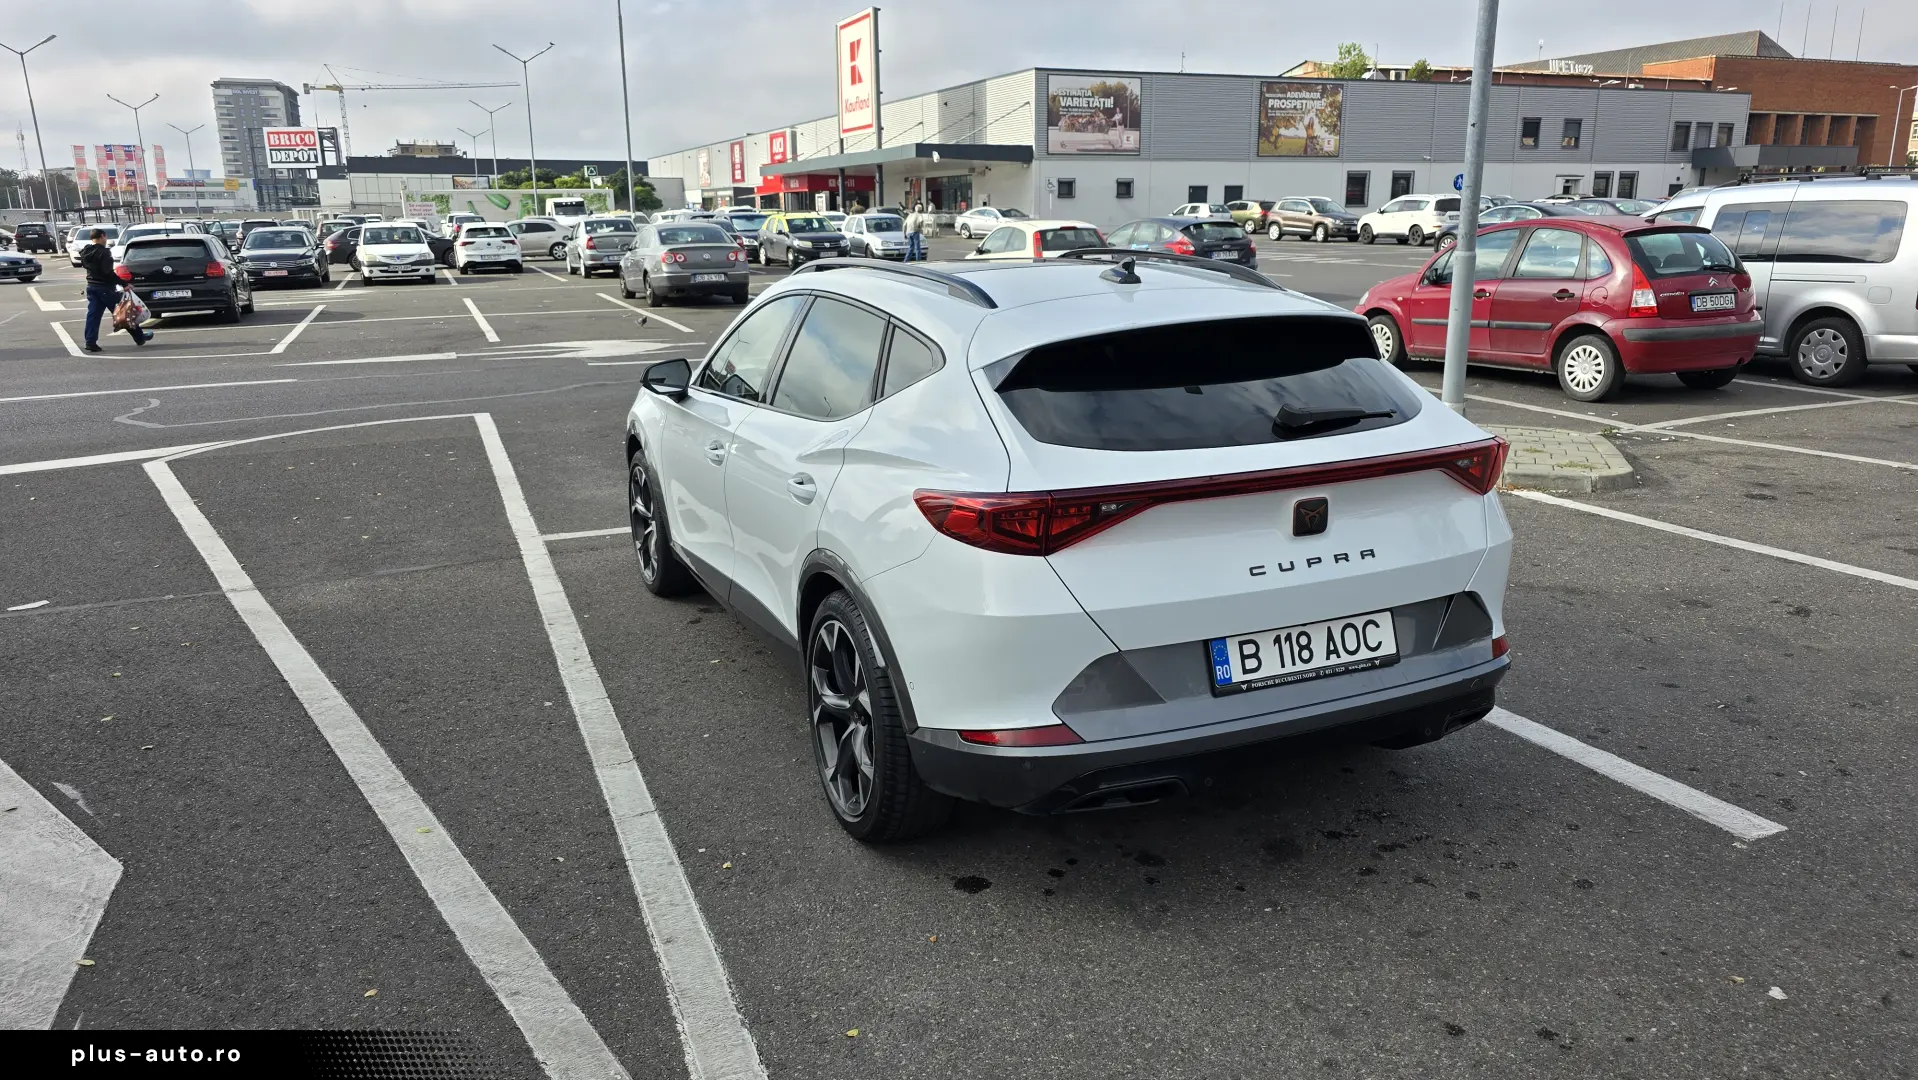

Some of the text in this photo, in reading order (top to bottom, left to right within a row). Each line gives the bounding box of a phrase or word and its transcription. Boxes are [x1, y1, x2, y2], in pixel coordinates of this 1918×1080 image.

[844, 92, 871, 114] Kaufland
[268, 133, 315, 146] BRICO
[1696, 296, 1708, 308] DB
[1248, 548, 1376, 577] CUPRA
[1237, 618, 1383, 675] B 118 AOC
[1216, 665, 1231, 680] RO
[1251, 679, 1275, 688] PORSCHE
[1302, 671, 1317, 679] NORD
